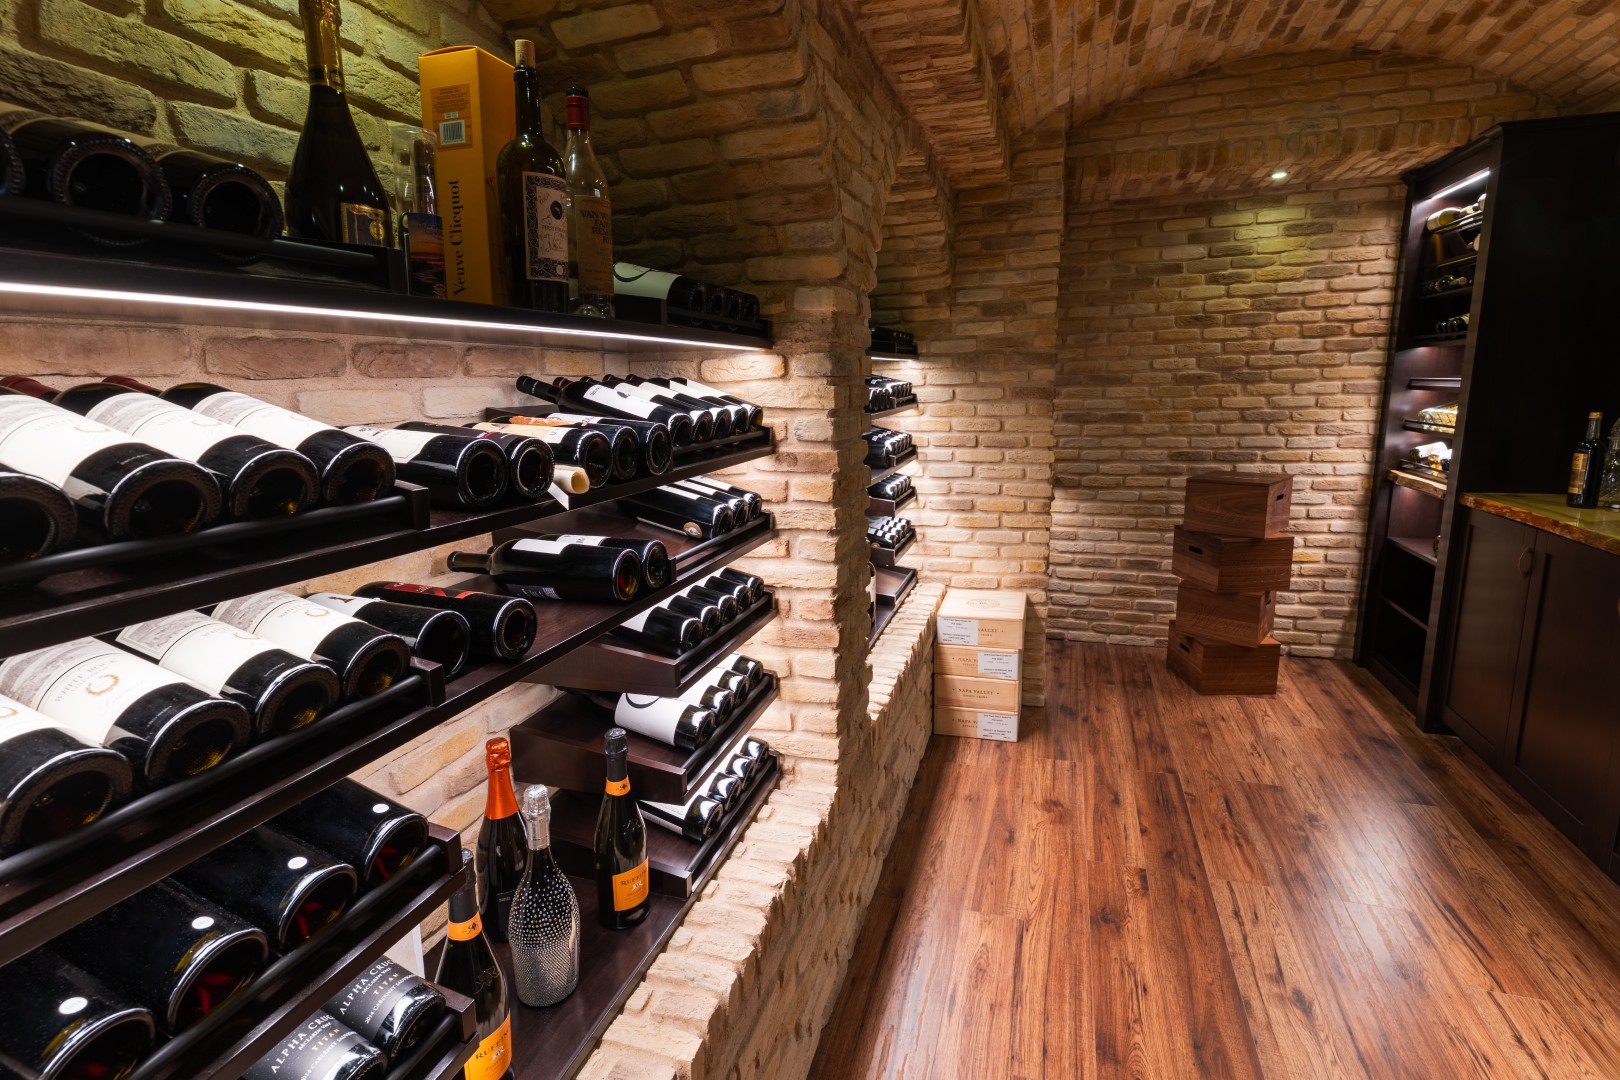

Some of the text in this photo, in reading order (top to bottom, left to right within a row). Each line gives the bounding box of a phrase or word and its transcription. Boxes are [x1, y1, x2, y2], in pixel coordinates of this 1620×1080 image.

[580, 210, 599, 218] VAN
[448, 178, 466, 295] Veuve Clicquot
[339, 977, 369, 1015] ALPHA
[373, 972, 400, 995] TITAN
[364, 1011, 375, 1024] 2014
[373, 985, 396, 1011] CABERNET
[271, 1032, 307, 1074] ALPHA
[311, 1028, 340, 1052] TITAN
[475, 1030, 509, 1060] RUFFIN
[300, 1069, 312, 1080] 014
[310, 1040, 337, 1069] CABERNET
